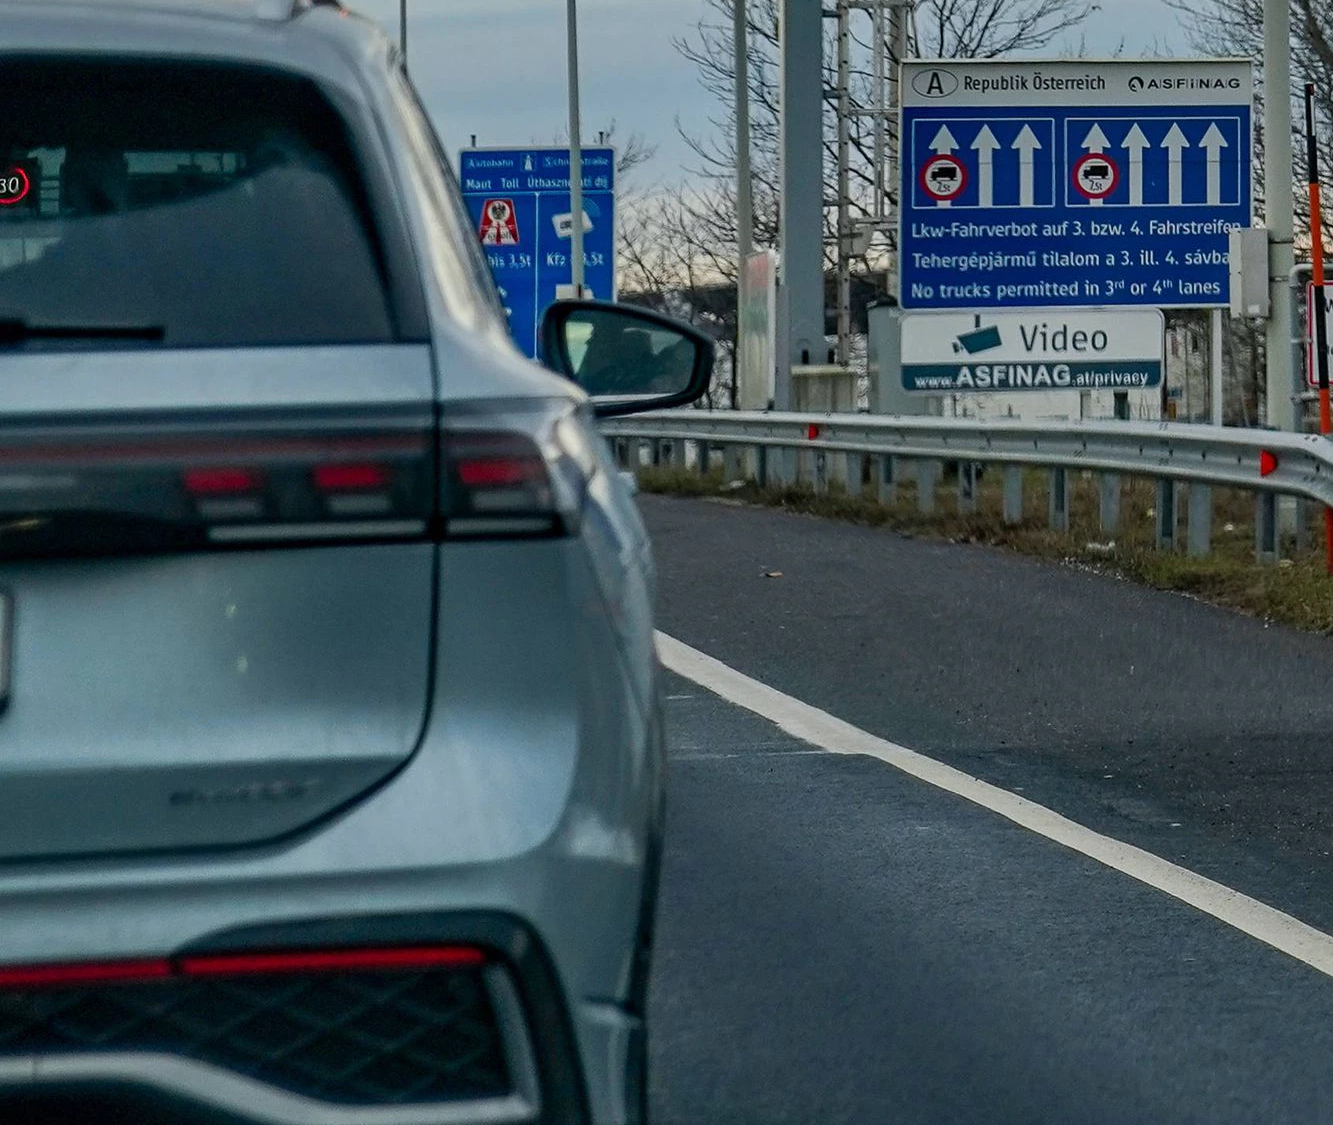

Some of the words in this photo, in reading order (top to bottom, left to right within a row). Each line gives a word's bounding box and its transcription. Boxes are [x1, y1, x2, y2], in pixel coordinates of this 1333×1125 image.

[926, 72, 943, 94] A
[964, 75, 1028, 93] Republik
[1033, 72, 1105, 90] Österreich
[501, 177, 520, 188] Toll
[912, 222, 1038, 238] Lkw-Fahrverbot
[1042, 221, 1069, 237] auf
[1073, 221, 1085, 236] 3.
[1091, 221, 1125, 236] bzw.
[1130, 220, 1143, 235] 4.
[912, 251, 1037, 271] Tehergépjármű
[1041, 250, 1100, 266] tilalom
[1105, 254, 1115, 266] a
[1120, 250, 1134, 266] 3.
[1140, 249, 1159, 266] ill.
[1165, 250, 1179, 265] 4.
[1185, 249, 1230, 265] sávba
[911, 282, 934, 299] No
[940, 281, 991, 299] trucks
[997, 280, 1079, 300] permitted
[1085, 279, 1100, 296] in
[1105, 279, 1125, 296] 3rd
[1130, 284, 1147, 295] or
[1152, 279, 1173, 295] 4th
[1178, 279, 1221, 295] lanes
[1019, 324, 1108, 352] Video
